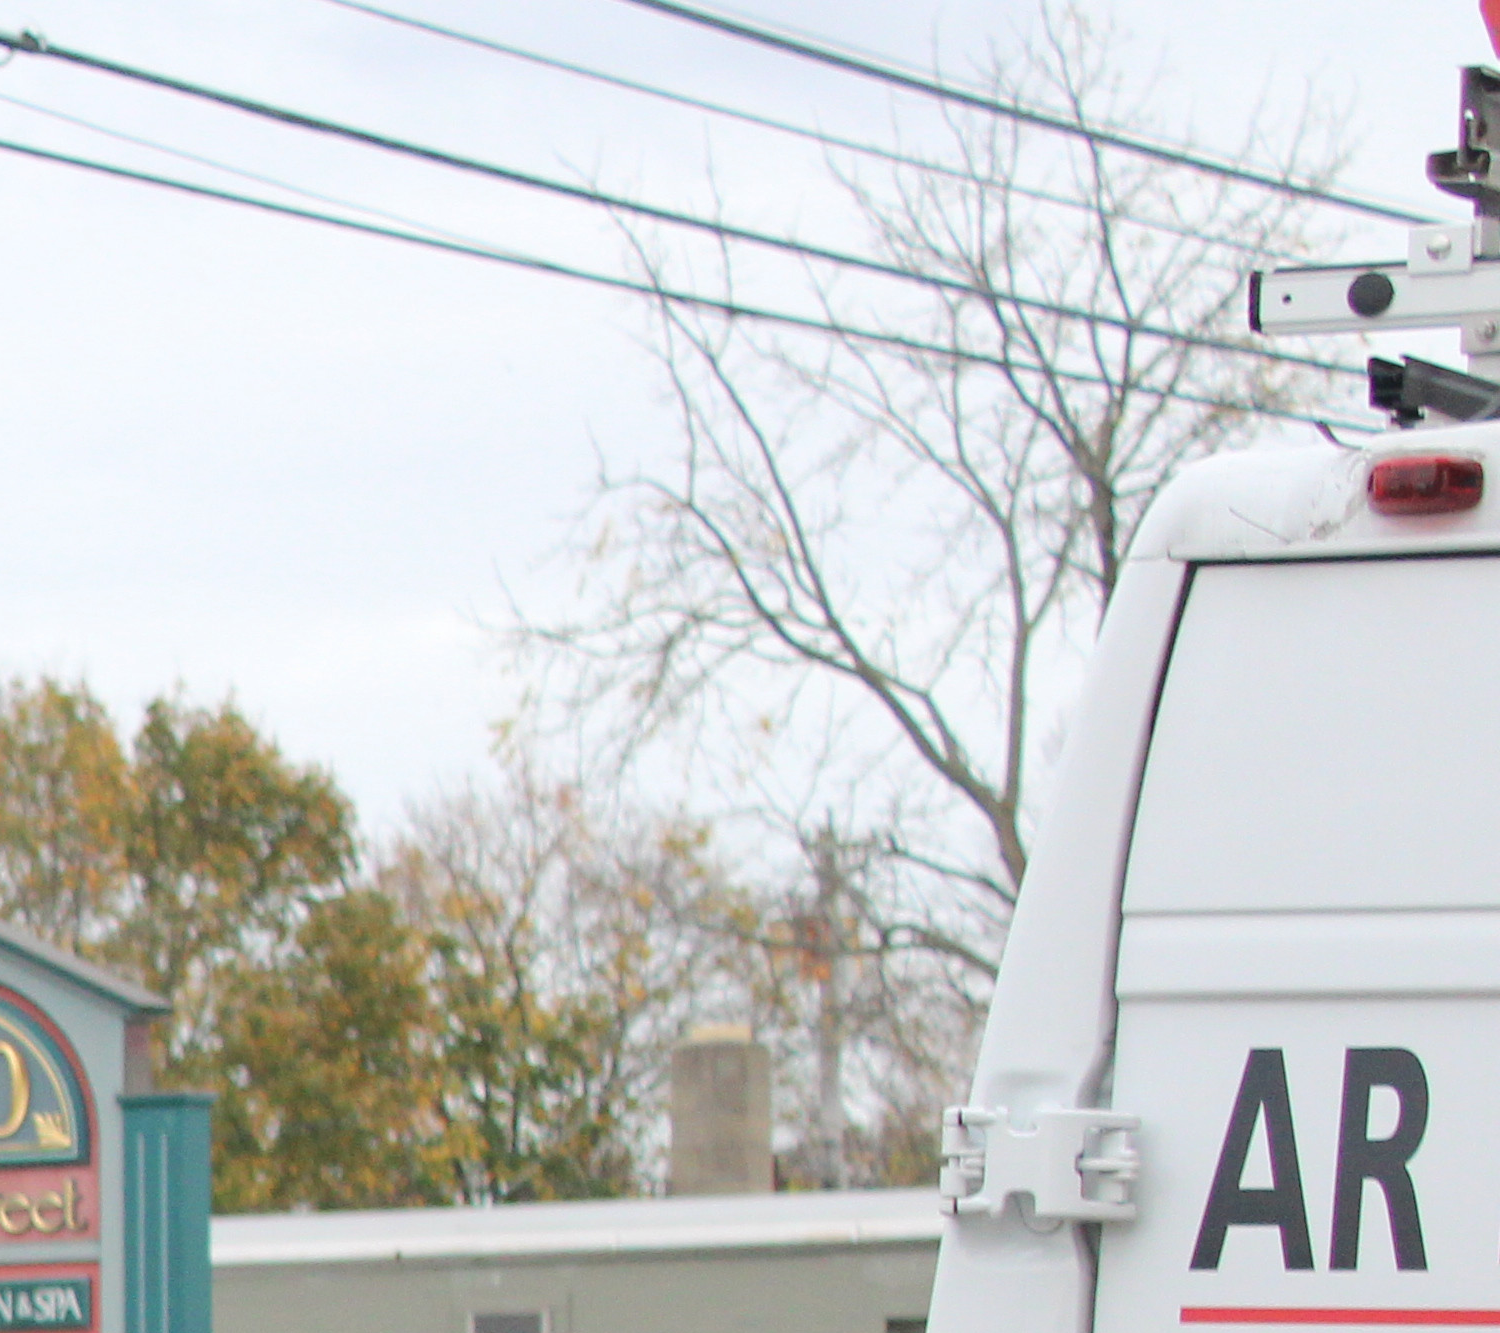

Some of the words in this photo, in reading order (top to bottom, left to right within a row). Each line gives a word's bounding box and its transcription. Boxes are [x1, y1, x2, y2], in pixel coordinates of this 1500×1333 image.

[1189, 1046, 1429, 1273] AR
[15, 1291, 33, 1319] &
[32, 1286, 83, 1322] SPA
